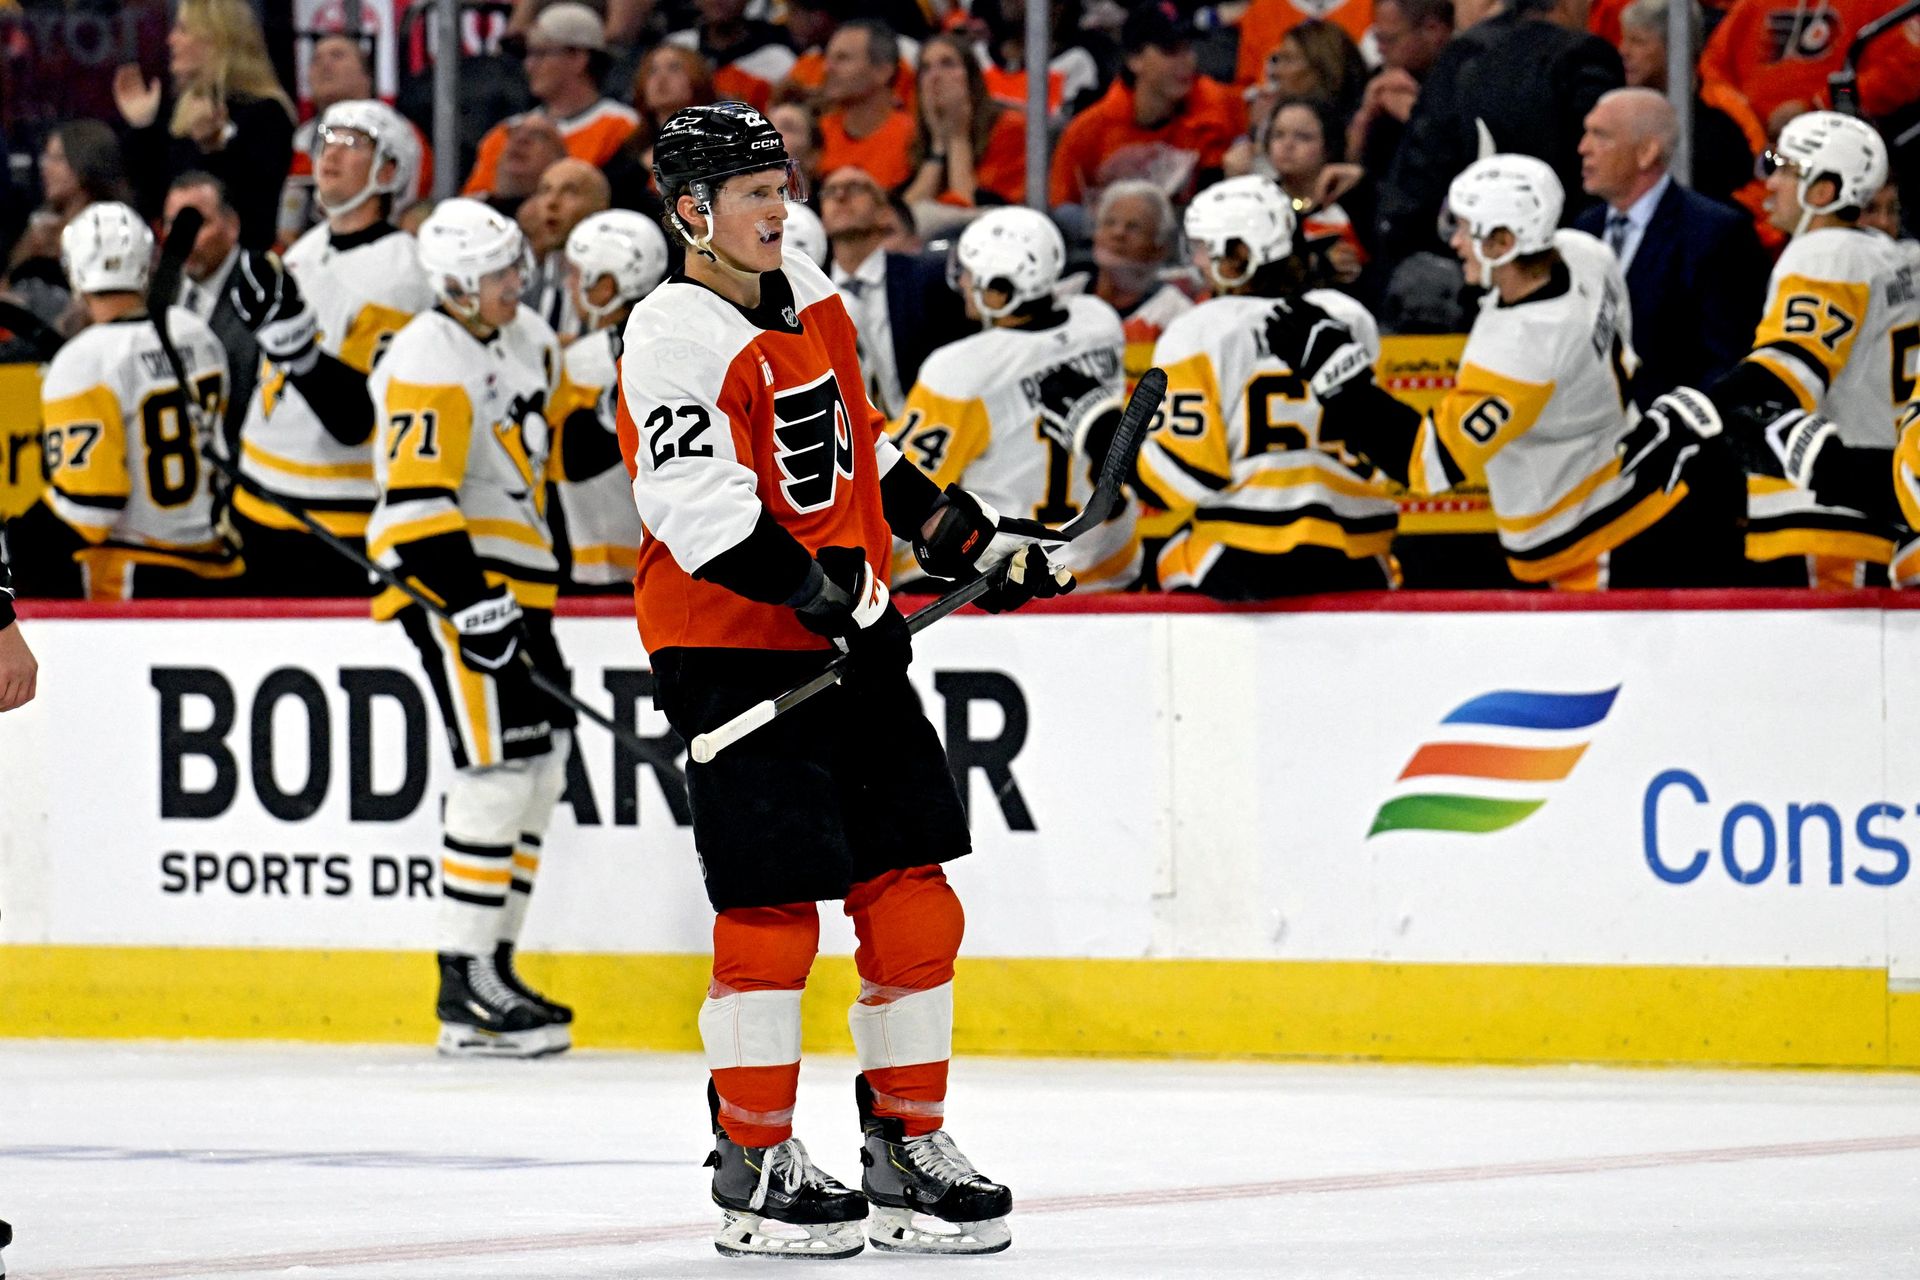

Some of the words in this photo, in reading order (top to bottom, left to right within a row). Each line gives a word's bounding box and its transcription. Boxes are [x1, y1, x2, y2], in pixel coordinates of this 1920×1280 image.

[751, 138, 780, 150] CCM
[1785, 296, 1854, 350] 57
[390, 411, 437, 460] 71
[645, 404, 713, 471] 22
[891, 413, 950, 470] 14
[1463, 400, 1511, 443] 6
[45, 425, 99, 467] 87
[1037, 417, 1081, 523] 1
[961, 529, 979, 554] 22
[161, 852, 350, 896] SPORTS
[372, 855, 434, 897] DR
